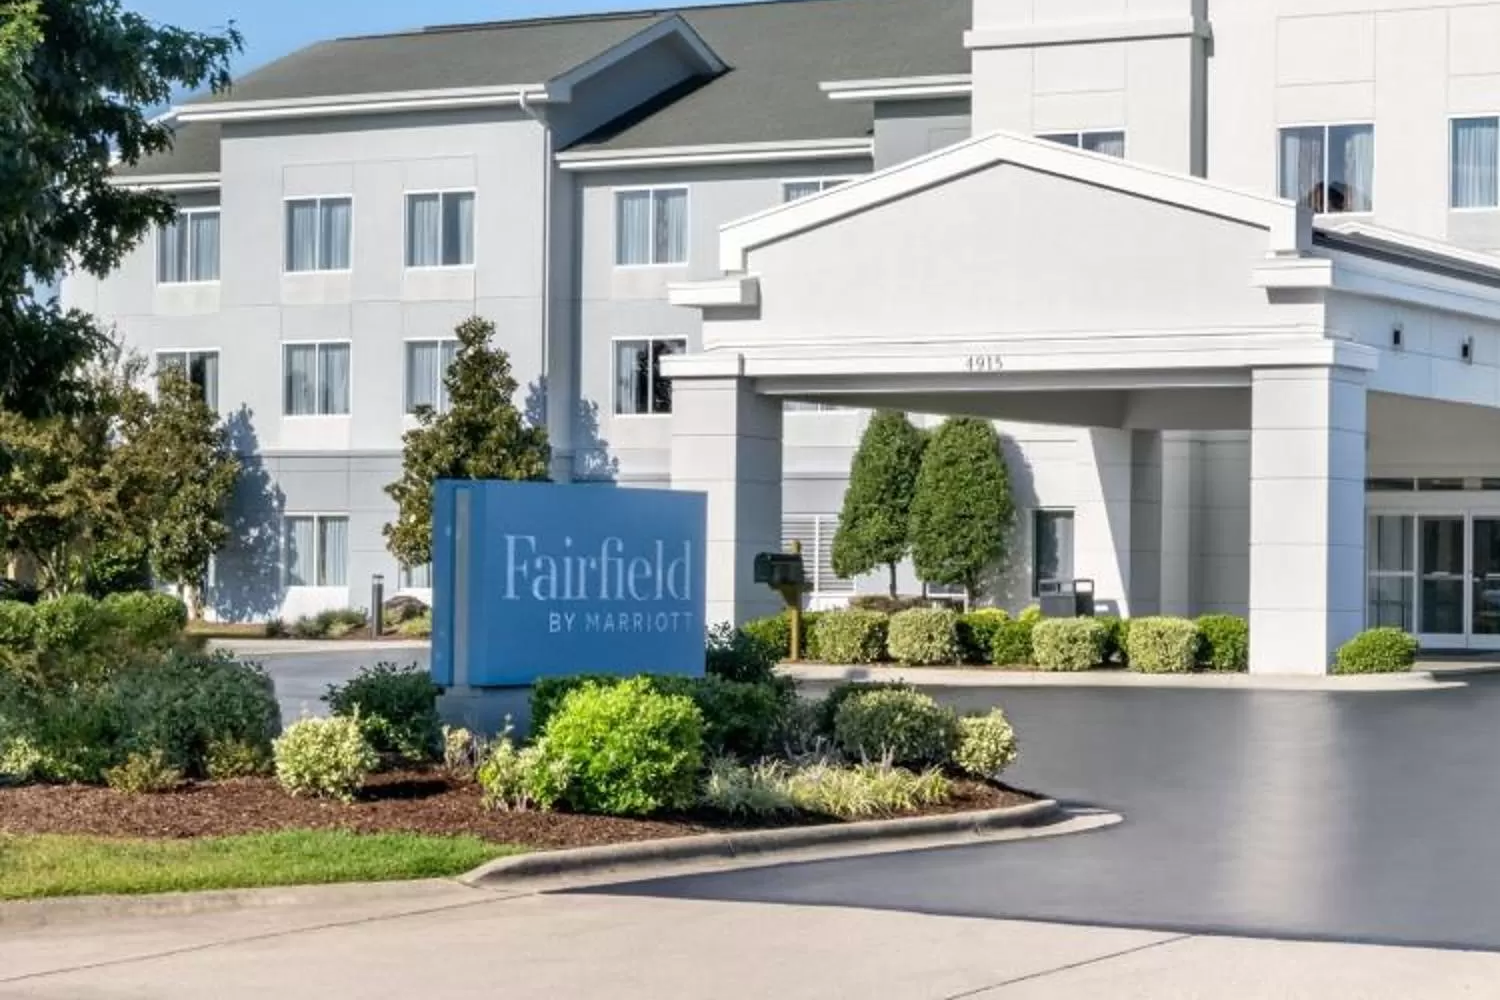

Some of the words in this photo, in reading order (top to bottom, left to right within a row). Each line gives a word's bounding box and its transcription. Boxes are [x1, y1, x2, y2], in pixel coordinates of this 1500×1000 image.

[964, 354, 1004, 372] 4915
[503, 534, 692, 601] Fairfield
[549, 612, 577, 633] BY
[585, 611, 694, 633] MARRIOTT
